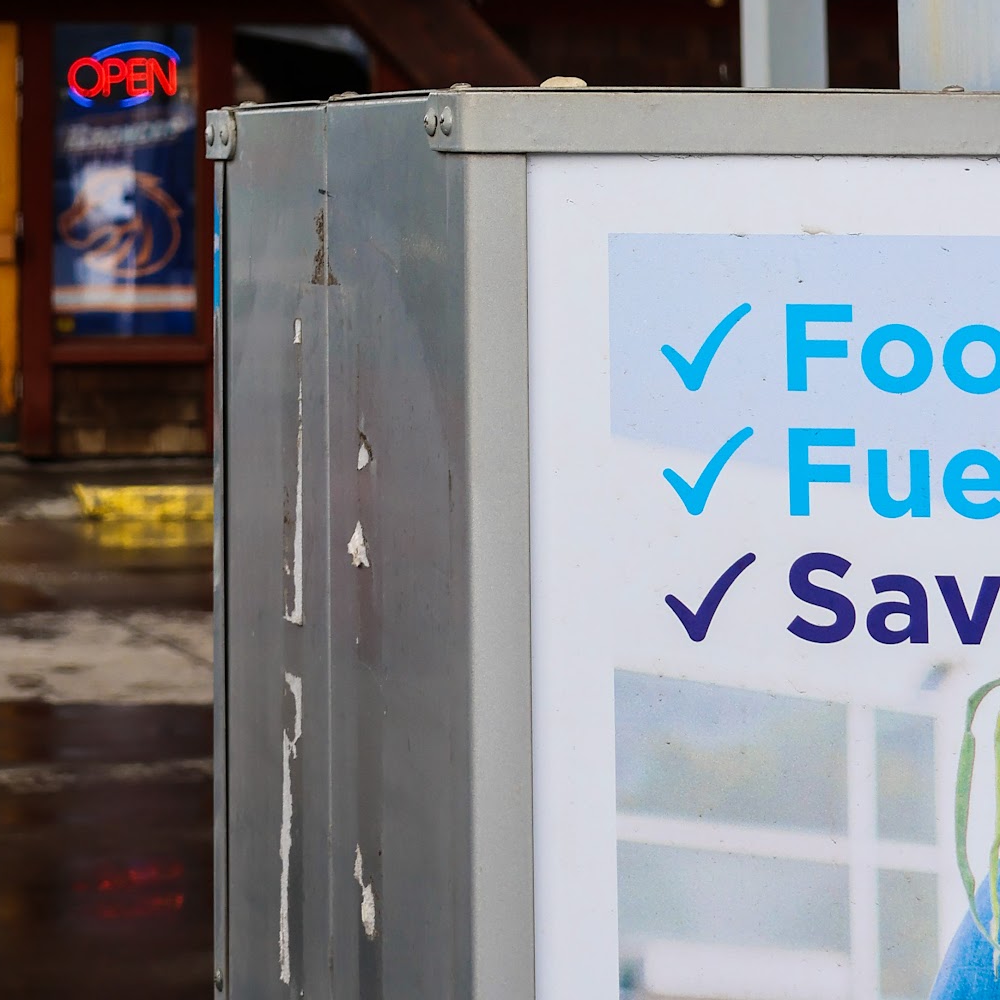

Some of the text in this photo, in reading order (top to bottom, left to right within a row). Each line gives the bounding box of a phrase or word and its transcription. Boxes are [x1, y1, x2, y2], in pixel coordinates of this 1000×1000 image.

[67, 56, 179, 98] OPEN
[786, 303, 1000, 395] Foo
[788, 427, 1000, 520] Fue
[787, 552, 1000, 645] Sav
